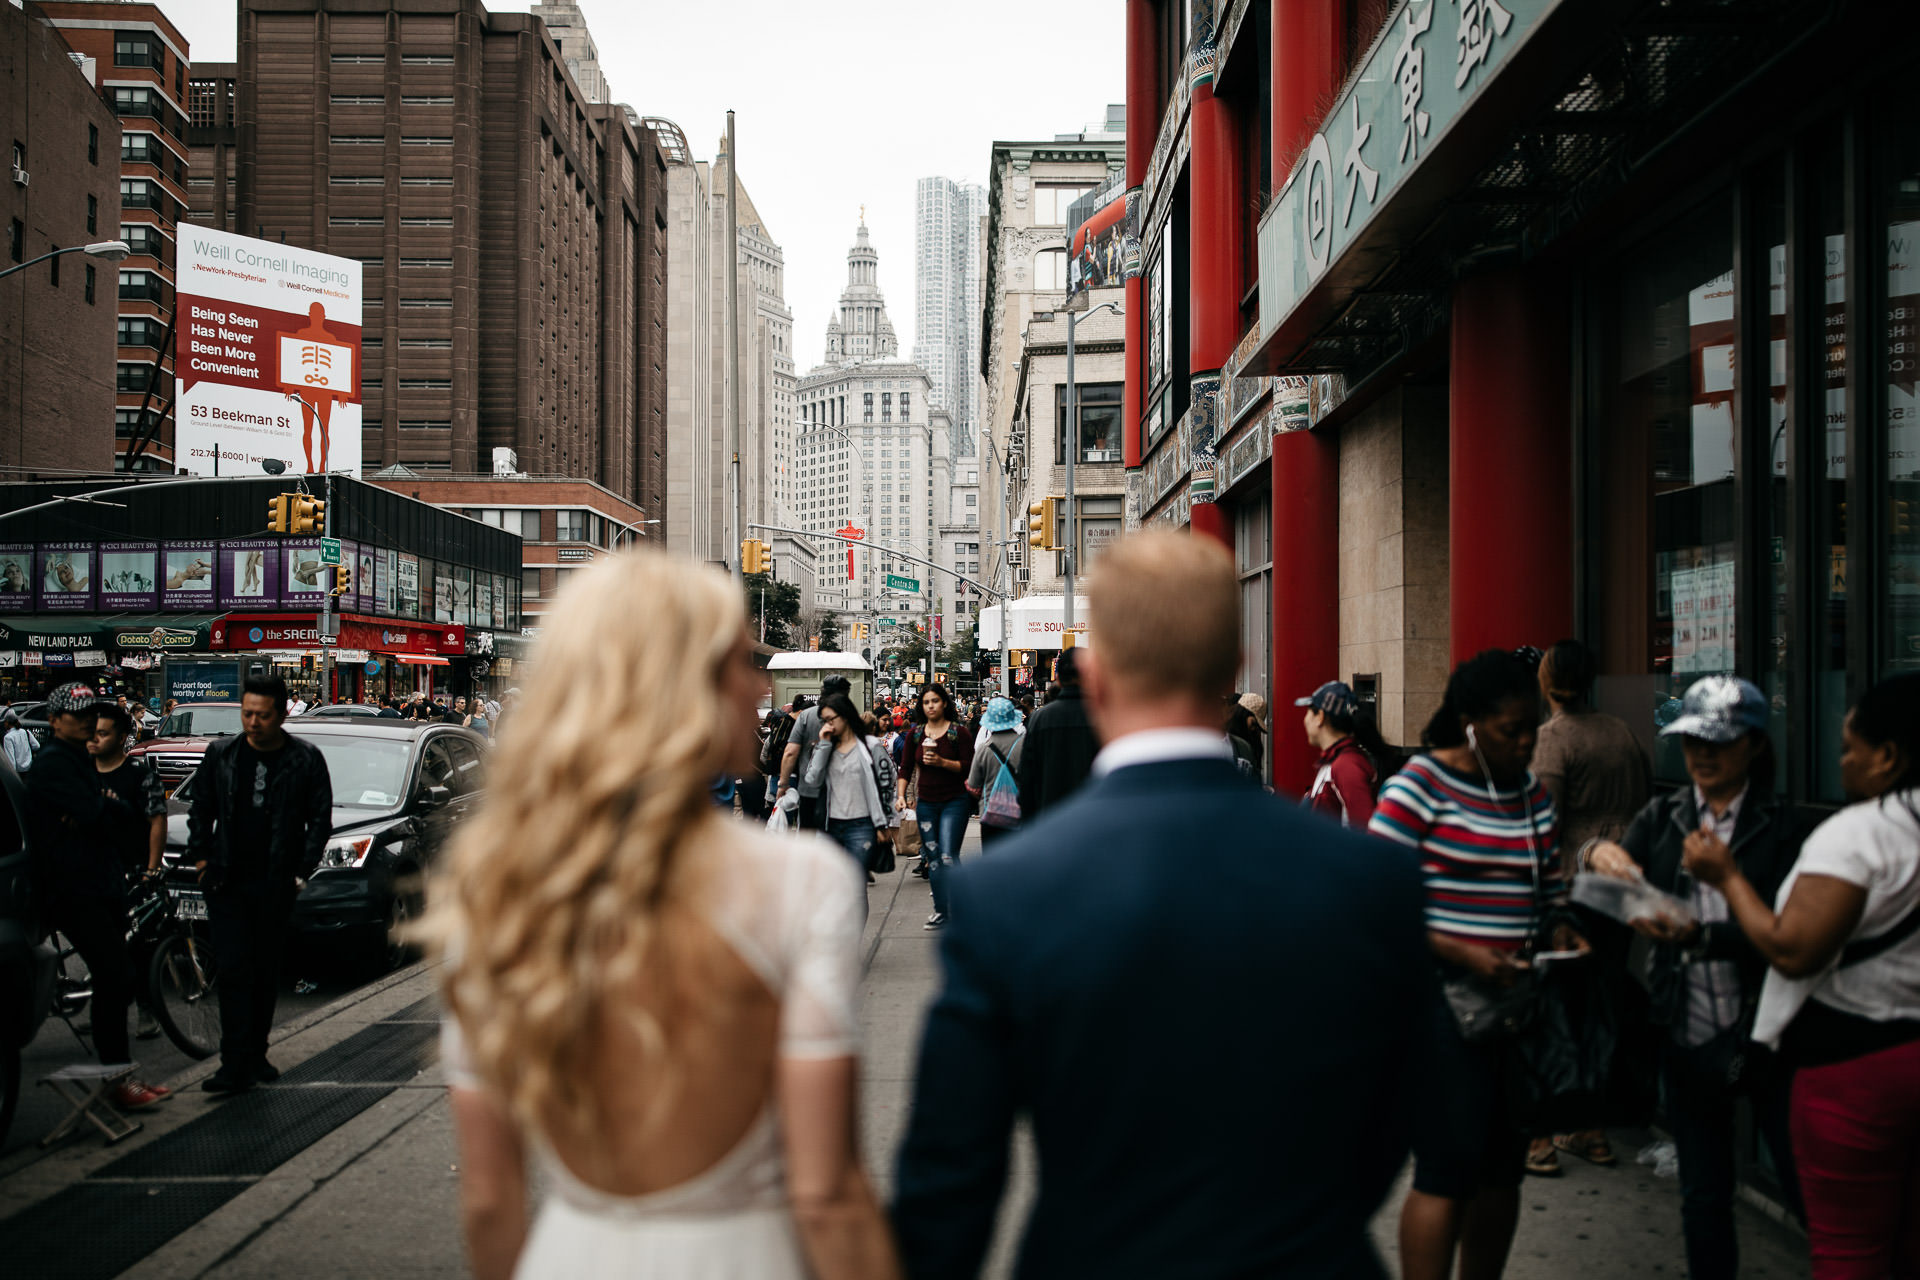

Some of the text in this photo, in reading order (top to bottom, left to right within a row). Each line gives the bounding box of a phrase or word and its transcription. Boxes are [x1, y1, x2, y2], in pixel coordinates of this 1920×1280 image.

[193, 239, 349, 287] Weill Cornell Imaging
[196, 263, 266, 284] NewYork-Presbyterian
[286, 281, 350, 300] Weill Cornell Medicine
[191, 306, 259, 329] Being Seen
[191, 323, 254, 344] Has Never
[190, 340, 256, 362] Been More
[190, 358, 260, 379] Convenient
[190, 405, 291, 429] 53 Beekman St
[891, 577, 914, 589] Centre St
[28, 635, 93, 647] NEW LAND PLAZA
[120, 635, 192, 645] Potato Corner
[266, 629, 319, 640] the SAEM
[44, 653, 73, 661] metroPCS
[172, 681, 212, 691] Airport food
[172, 689, 230, 698] worthy of #foodie
